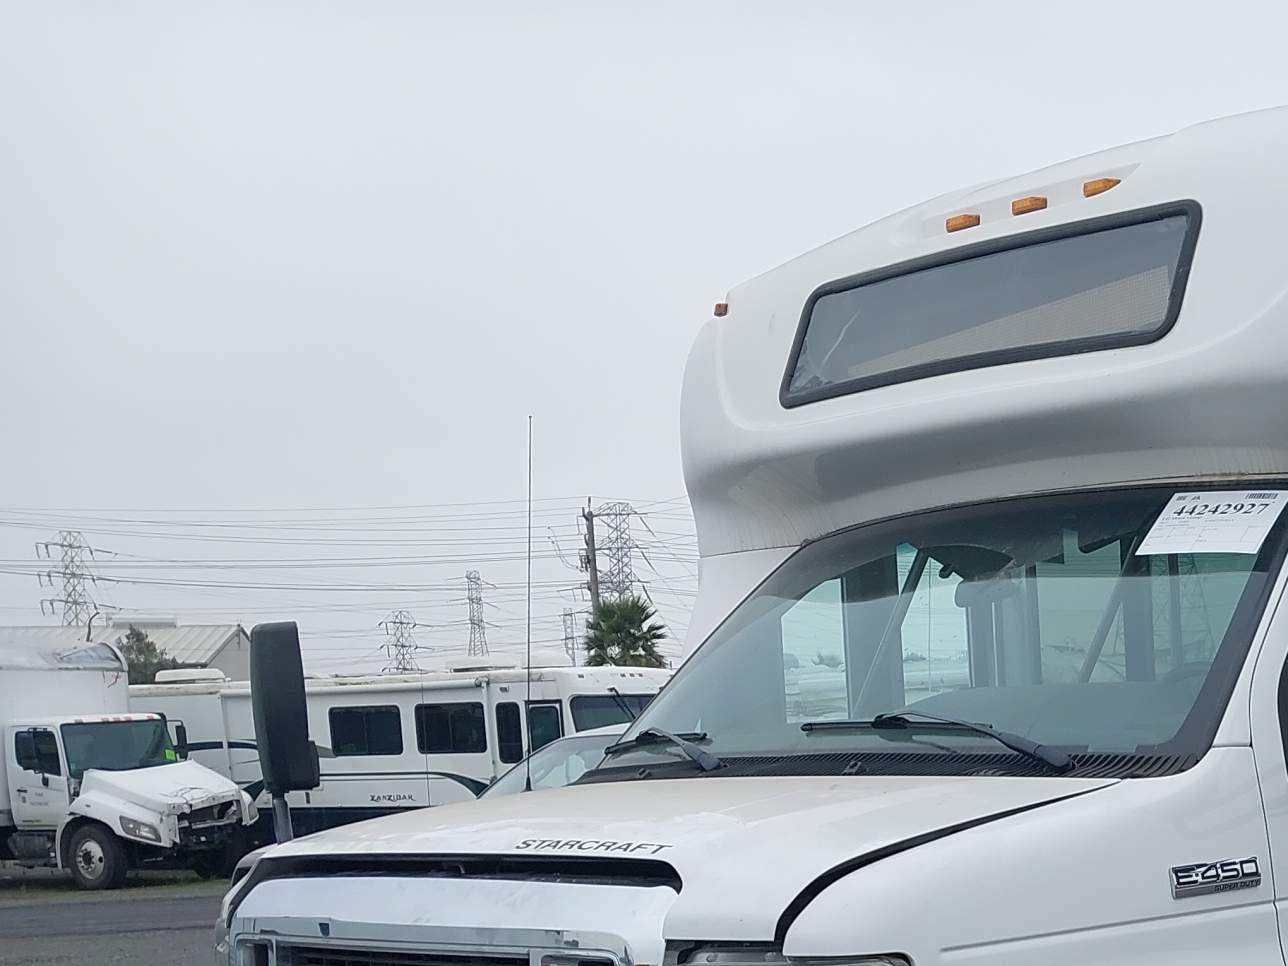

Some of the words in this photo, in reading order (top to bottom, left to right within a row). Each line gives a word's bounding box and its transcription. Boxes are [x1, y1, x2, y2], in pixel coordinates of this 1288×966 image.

[1173, 503, 1270, 516] 44242927
[515, 839, 673, 854] STARCRAFT
[1172, 859, 1260, 886] E-450
[1215, 883, 1240, 892] SUPER
[1241, 879, 1260, 889] DUTY
